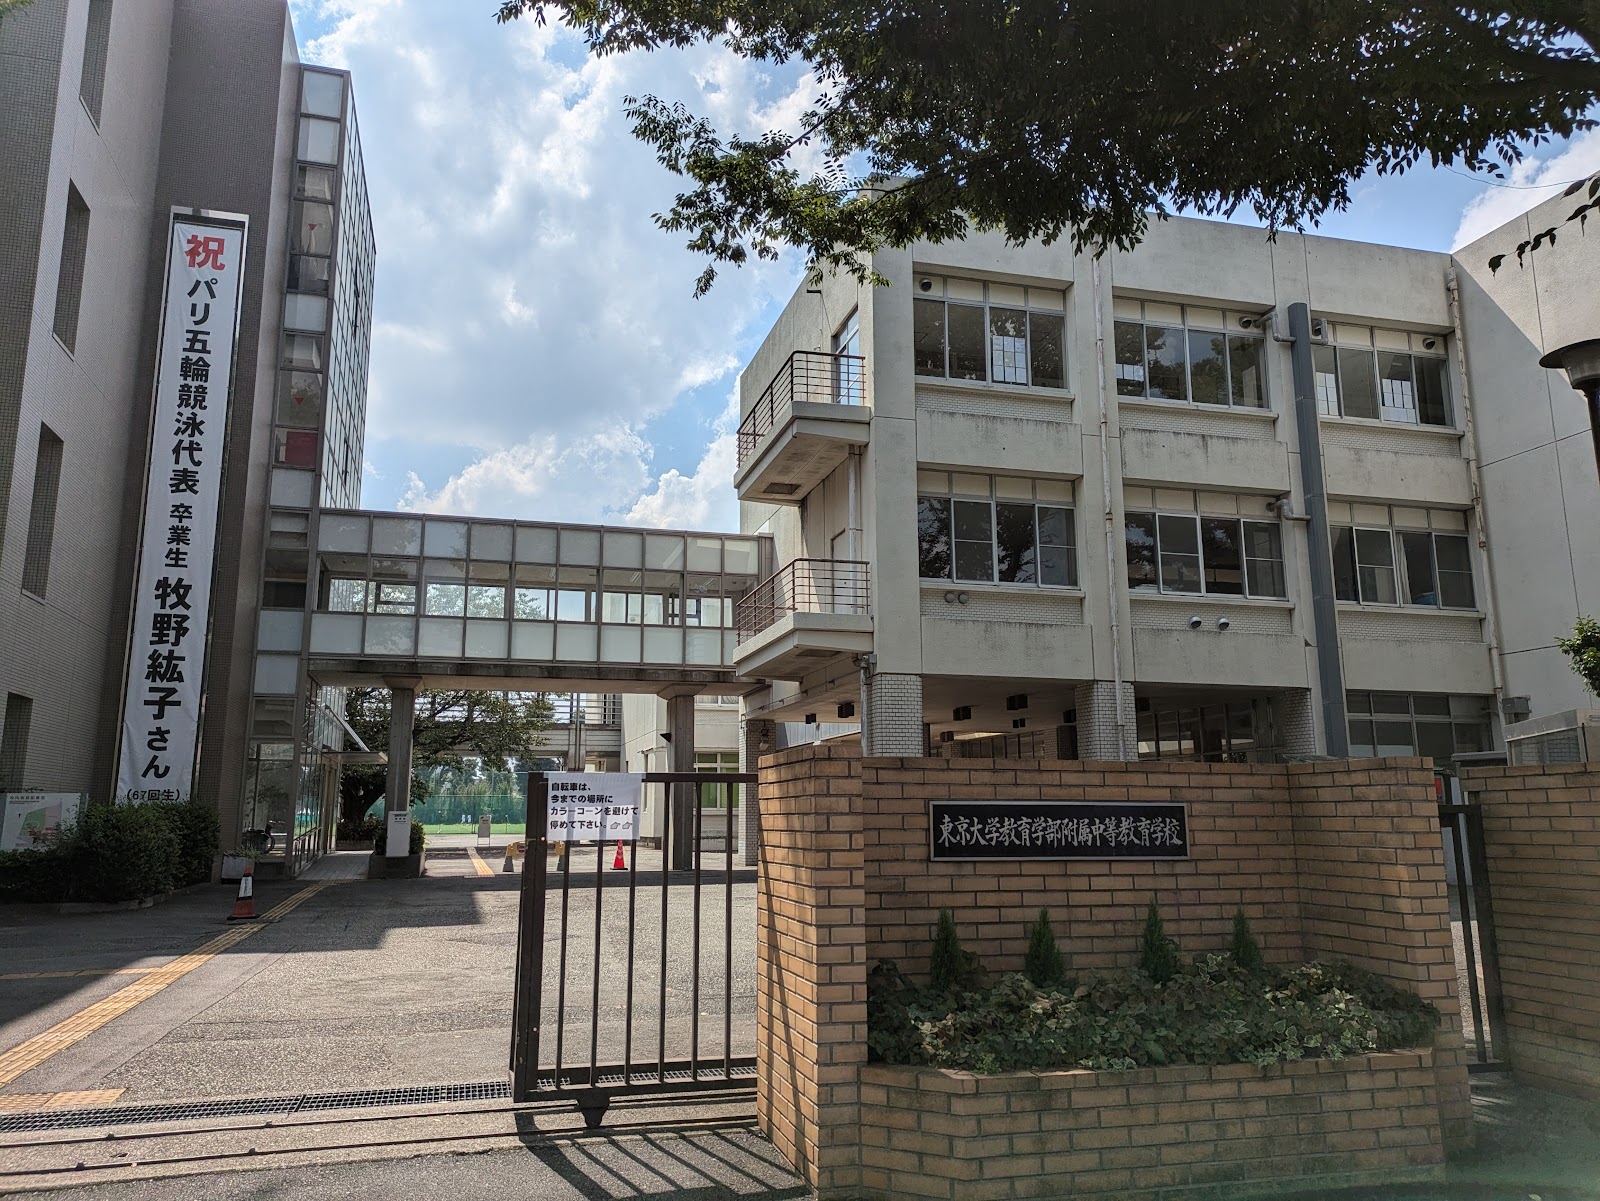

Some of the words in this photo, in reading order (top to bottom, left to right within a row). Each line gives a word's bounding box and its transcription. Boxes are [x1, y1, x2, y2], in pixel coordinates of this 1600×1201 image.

[184, 234, 226, 271] 祝
[168, 277, 219, 495] パリ五輪競泳代表
[164, 502, 193, 569] 卒業生
[141, 576, 193, 780] 牧野紘子さん
[126, 788, 181, 801] (67回生)
[550, 794, 614, 804] 今までの場所に
[551, 782, 591, 792] 自転車は、
[550, 806, 639, 816] カラーコーンを避けて
[549, 820, 607, 830] 停めて下さい。
[937, 813, 1184, 848] 東京大学教育学部附属中等教育学校
